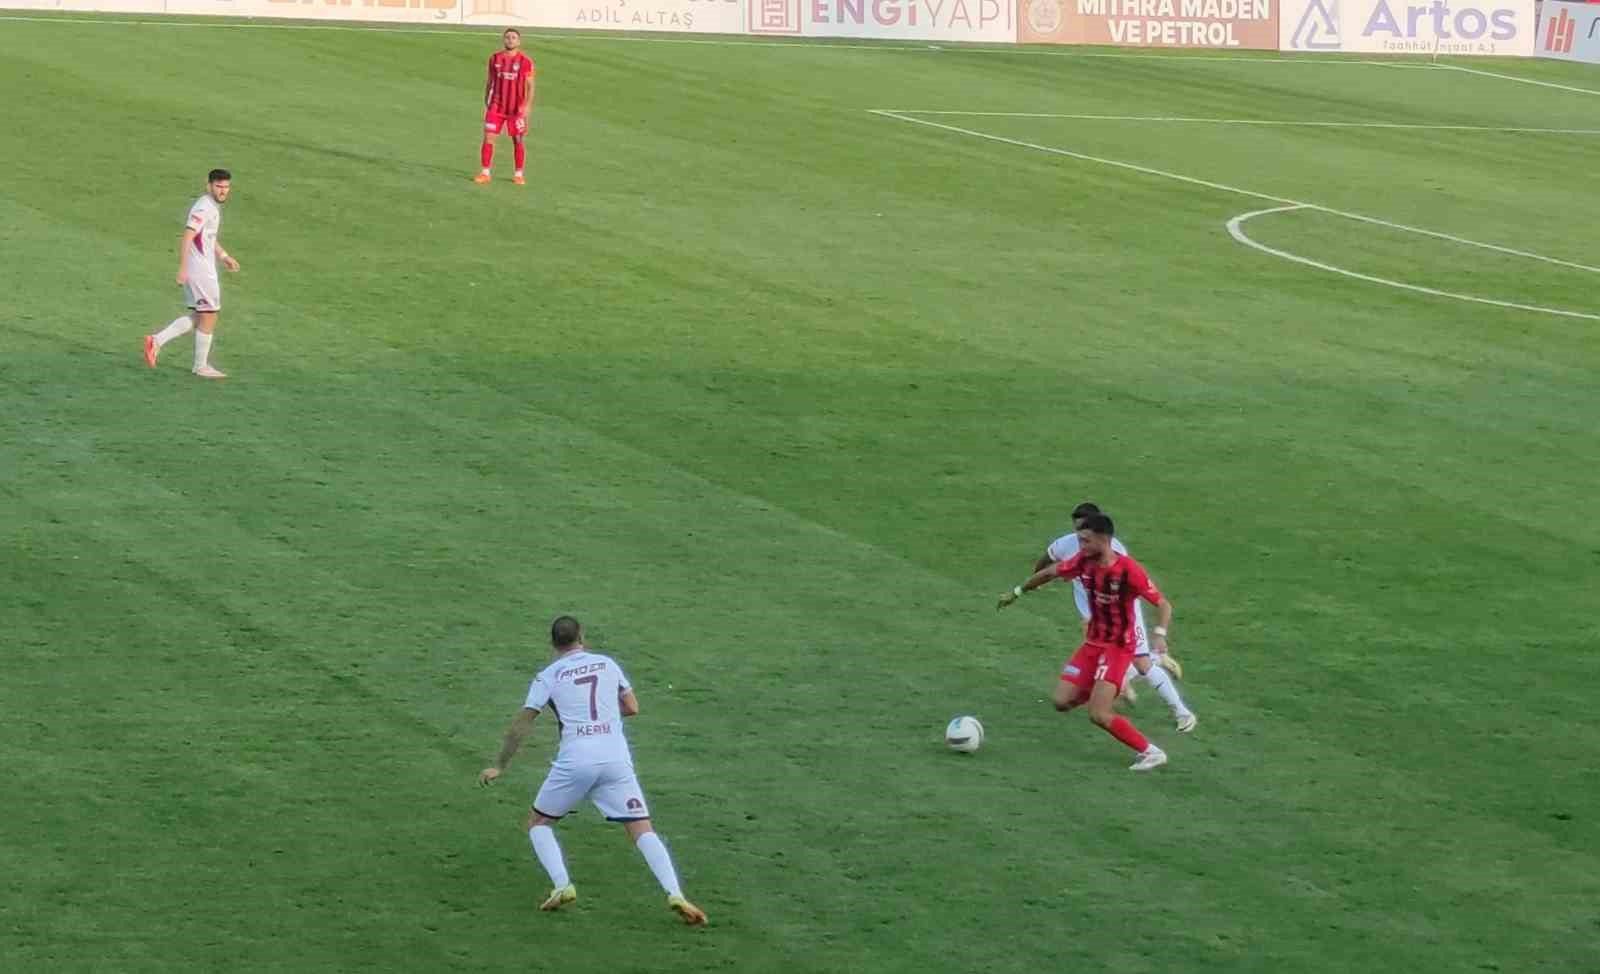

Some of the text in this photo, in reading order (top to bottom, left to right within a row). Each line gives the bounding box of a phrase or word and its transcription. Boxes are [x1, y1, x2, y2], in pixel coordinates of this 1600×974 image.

[576, 9, 694, 29] ADİL ALTAŞ
[1181, 0, 1269, 20] MADEN
[1362, 0, 1517, 40] Artos
[1107, 19, 1239, 46] VE PETROL
[574, 674, 598, 721] 7
